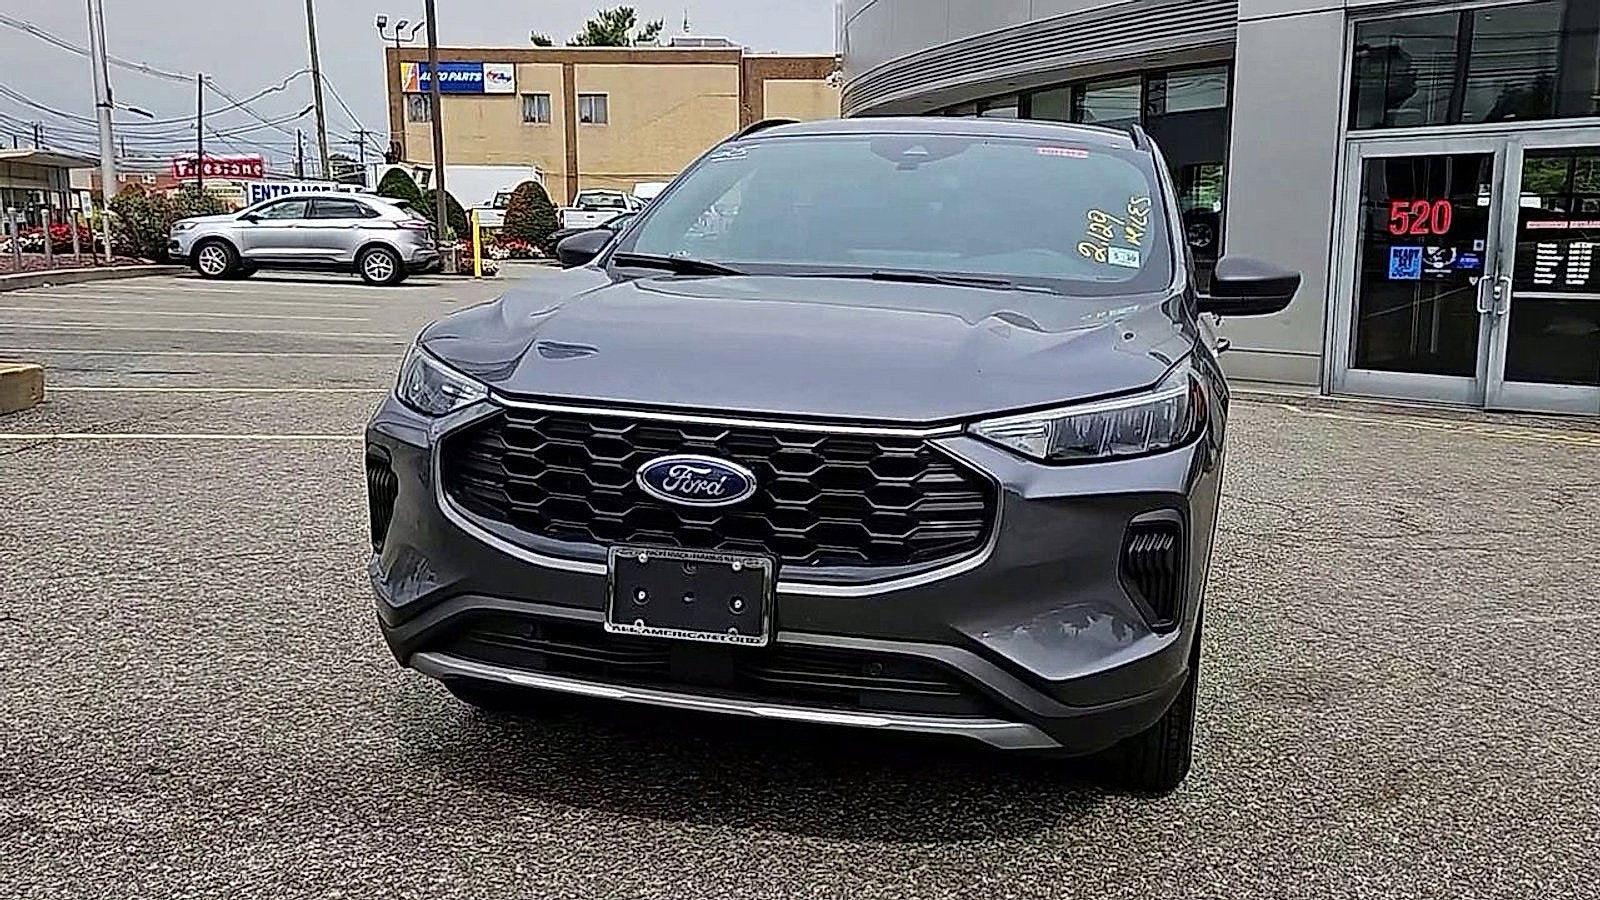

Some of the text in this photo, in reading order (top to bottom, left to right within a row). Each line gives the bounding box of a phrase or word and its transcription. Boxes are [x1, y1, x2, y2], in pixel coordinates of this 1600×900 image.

[420, 71, 483, 82] AUO PARTS
[1123, 196, 1152, 246] MILES
[1389, 200, 1452, 235] 520
[662, 464, 728, 496] Ford
[641, 627, 720, 641] AMERICAN
